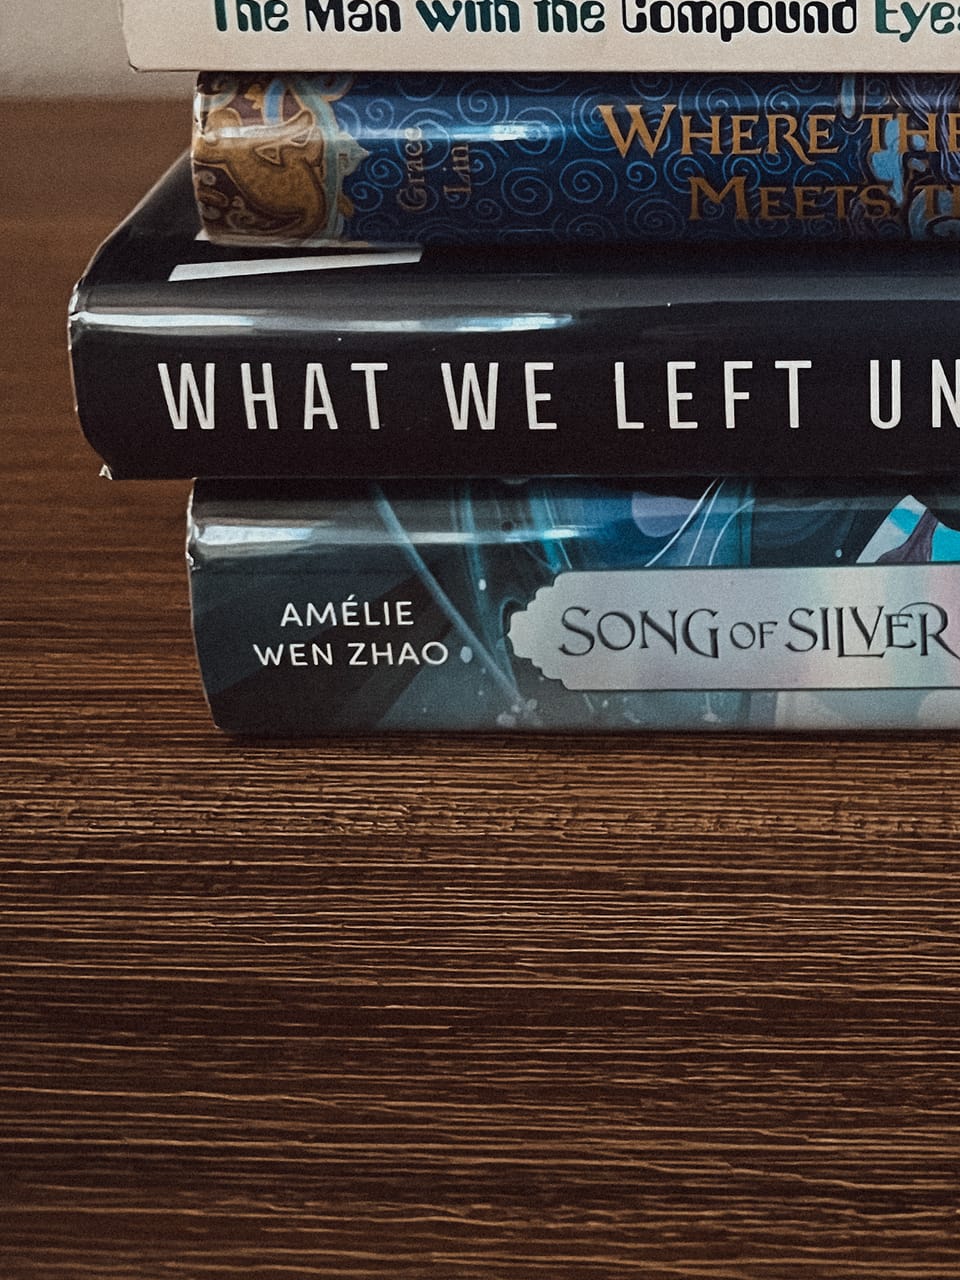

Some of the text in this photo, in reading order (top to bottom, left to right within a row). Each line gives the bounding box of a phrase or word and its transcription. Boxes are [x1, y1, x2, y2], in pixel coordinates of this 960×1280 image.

[598, 103, 842, 166] WHERE
[396, 127, 428, 212] Grace
[442, 143, 472, 195] Lin
[687, 175, 898, 222] MEETS
[157, 362, 389, 431] WHAT
[441, 361, 558, 431] WE
[614, 360, 813, 430] LEFT
[280, 594, 415, 628] AMÉLIE
[557, 605, 721, 660] SONG
[728, 619, 779, 650] OF
[252, 641, 450, 667] WEN ZHAO
